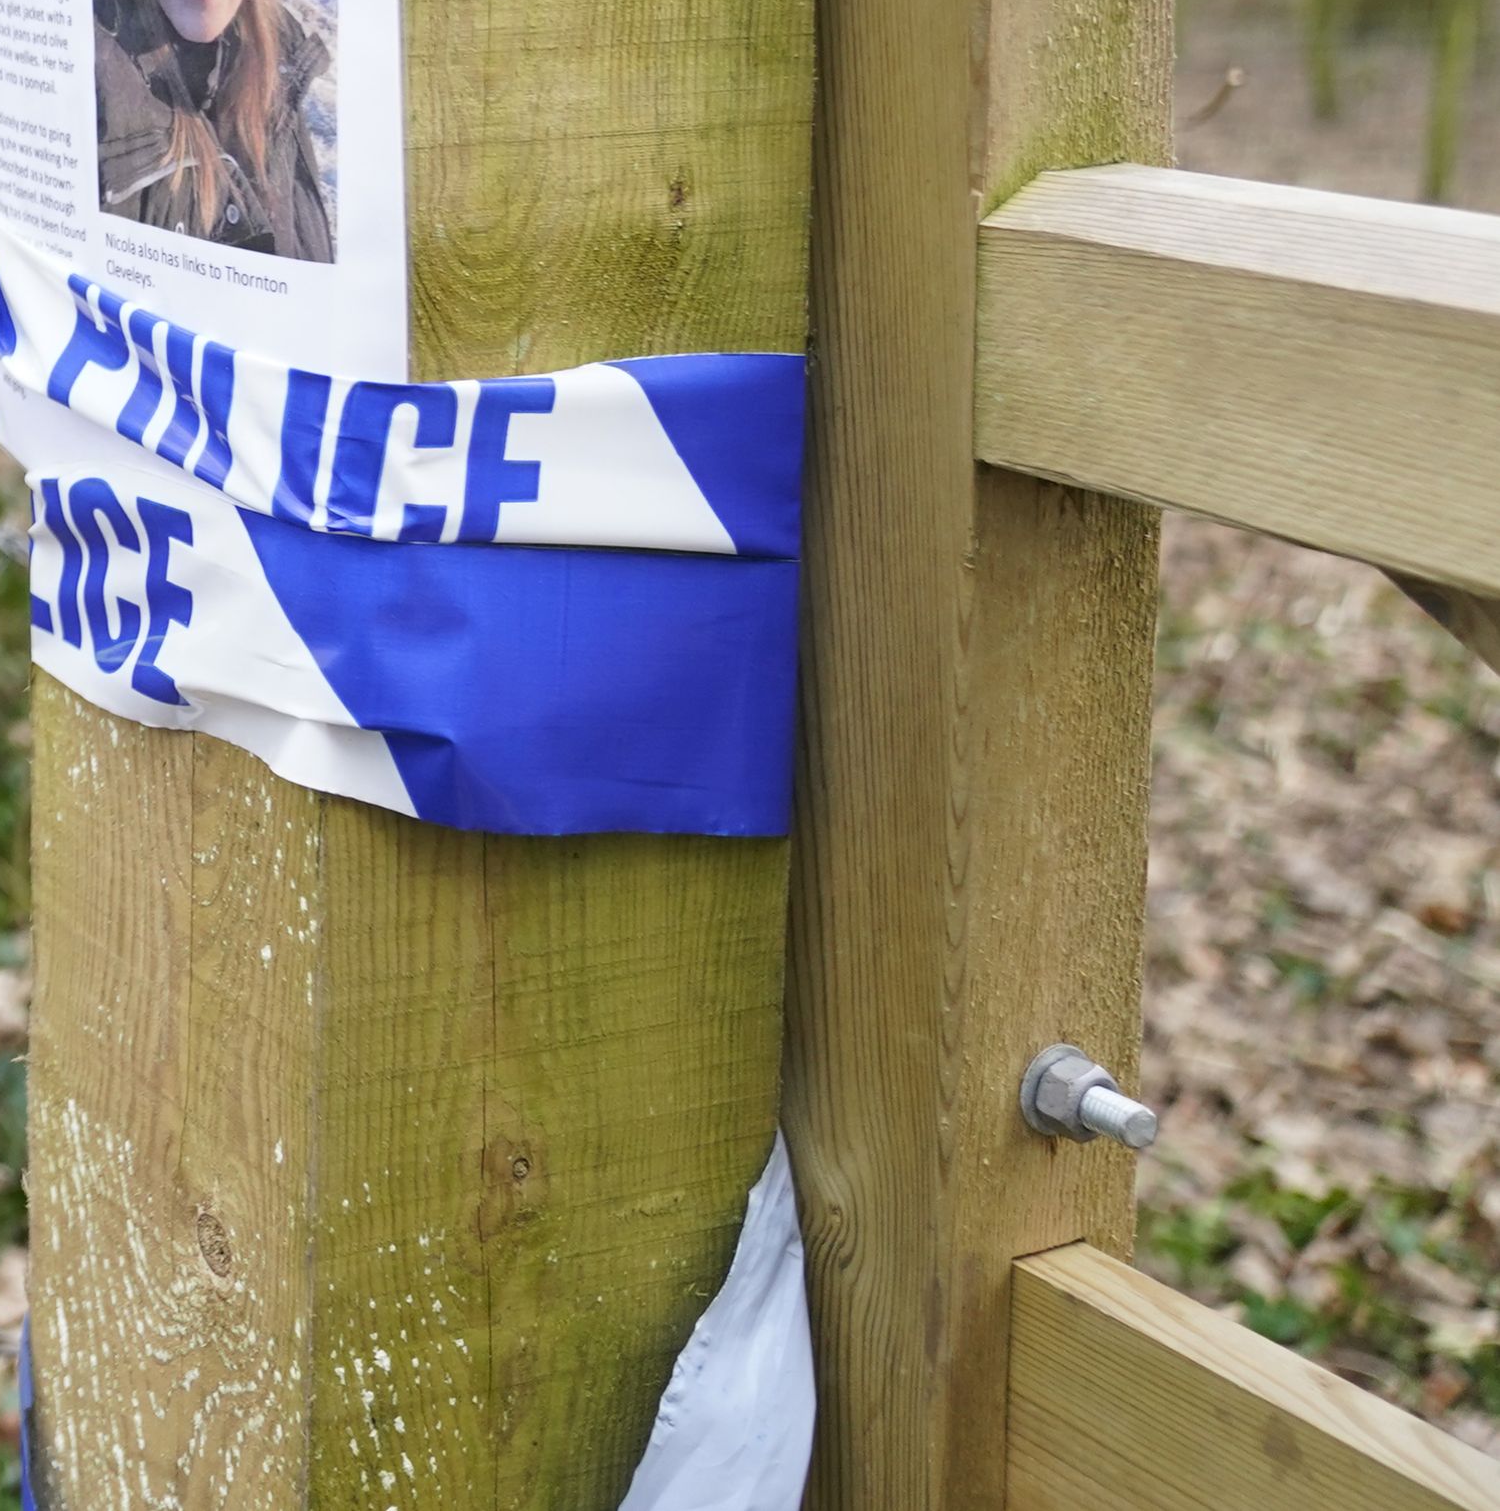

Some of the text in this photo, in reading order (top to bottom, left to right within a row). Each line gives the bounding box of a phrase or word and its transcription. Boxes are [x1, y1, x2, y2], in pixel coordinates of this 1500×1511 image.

[23, 5, 46, 23] jacket
[47, 9, 65, 27] with
[12, 26, 31, 43] jeans
[32, 30, 48, 47] and
[49, 33, 69, 51] olive
[42, 53, 57, 71] Her
[58, 56, 76, 74] hair
[48, 127, 72, 149] going
[18, 143, 33, 158] was
[33, 148, 62, 170] walking
[63, 152, 79, 170] her
[39, 192, 77, 218] Although
[40, 217, 60, 235] been
[60, 219, 87, 244] found
[104, 232, 289, 295] Nicola also has links to Thornton
[105, 258, 157, 289] Cleveleys.
